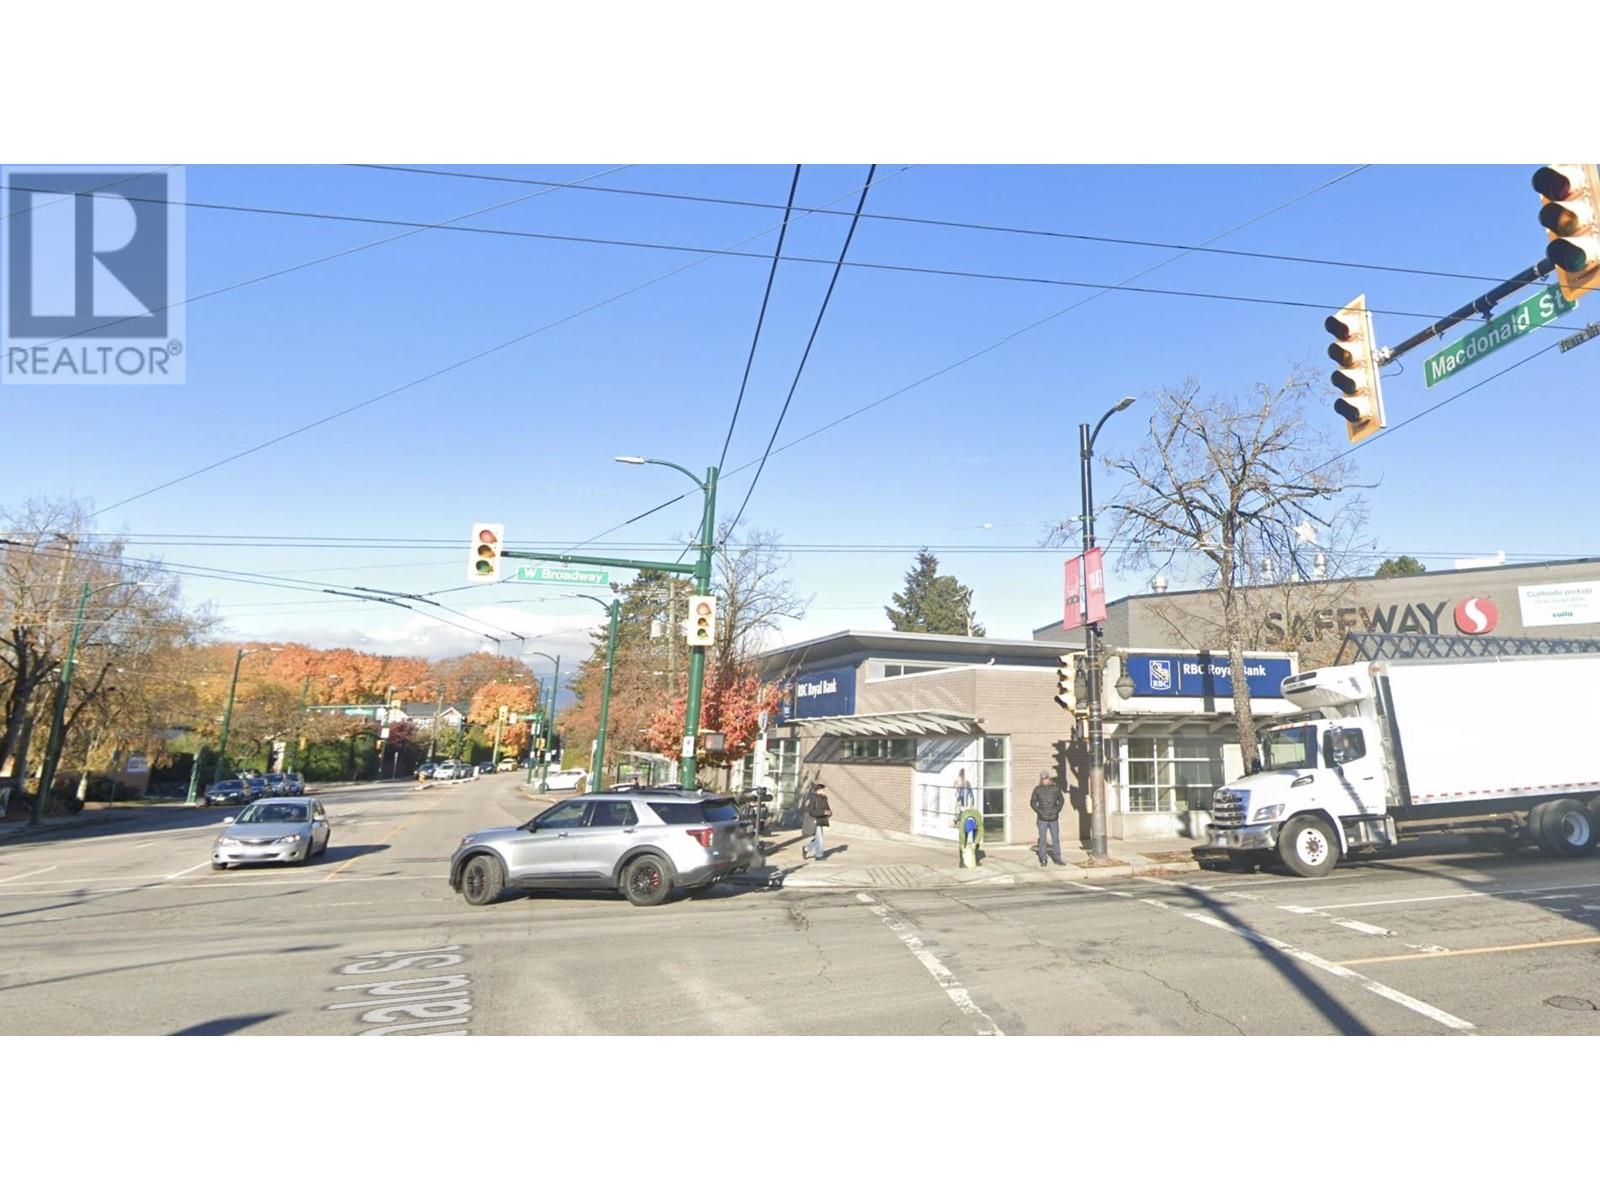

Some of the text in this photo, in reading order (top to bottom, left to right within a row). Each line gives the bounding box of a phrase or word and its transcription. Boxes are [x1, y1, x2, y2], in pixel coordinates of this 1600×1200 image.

[1431, 306, 1531, 380] Macdonald
[1539, 289, 1565, 318] St
[523, 566, 603, 585] W Broadway
[1183, 663, 1206, 675] RBC
[1208, 664, 1233, 678] Roya
[823, 677, 838, 693] Bank
[340, 943, 470, 976] St
